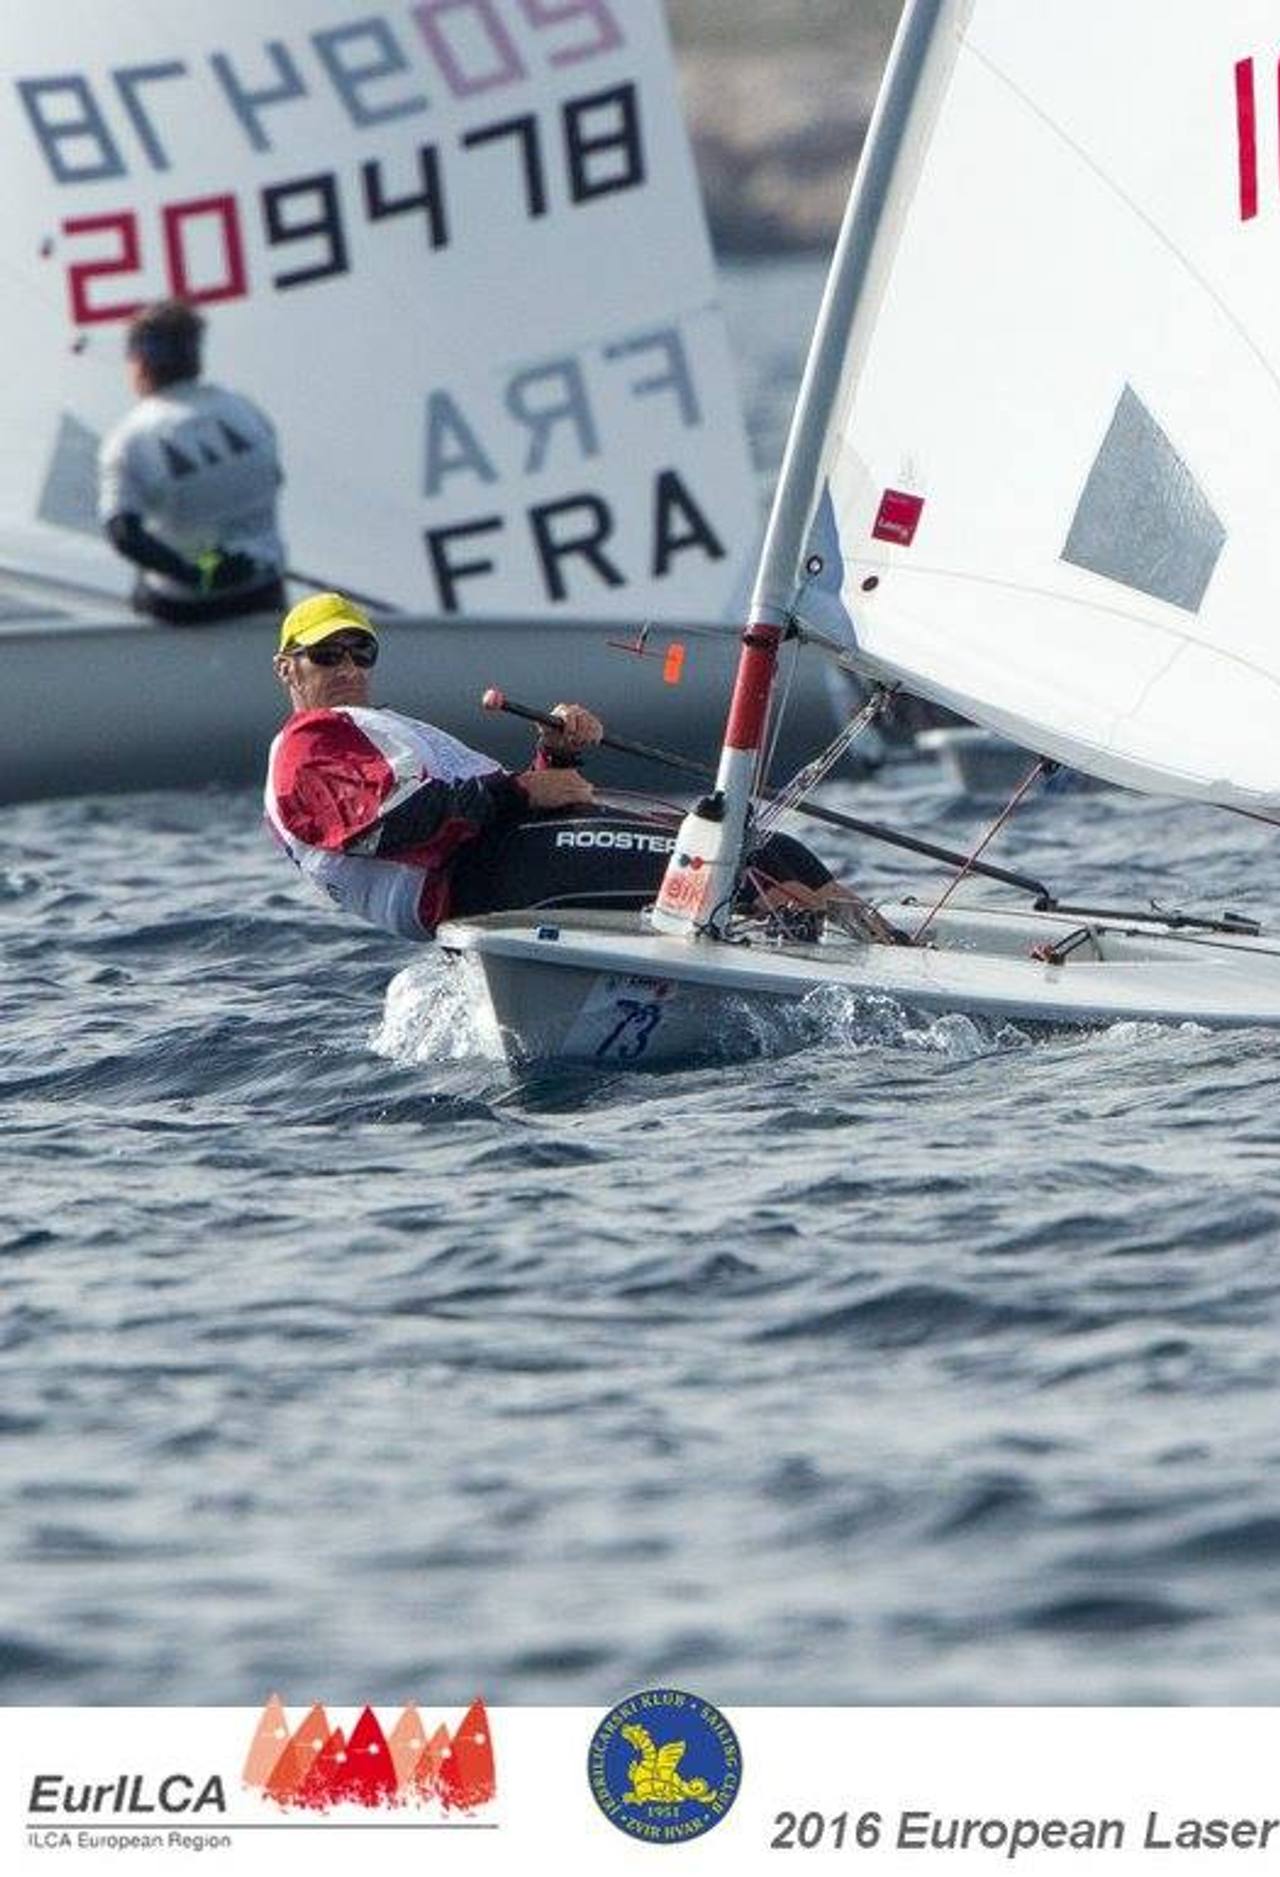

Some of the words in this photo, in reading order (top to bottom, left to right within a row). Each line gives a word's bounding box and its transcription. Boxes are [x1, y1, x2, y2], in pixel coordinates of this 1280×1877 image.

[60, 82, 646, 326] 209478
[424, 468, 727, 613] FRA
[596, 999, 661, 1058] 73
